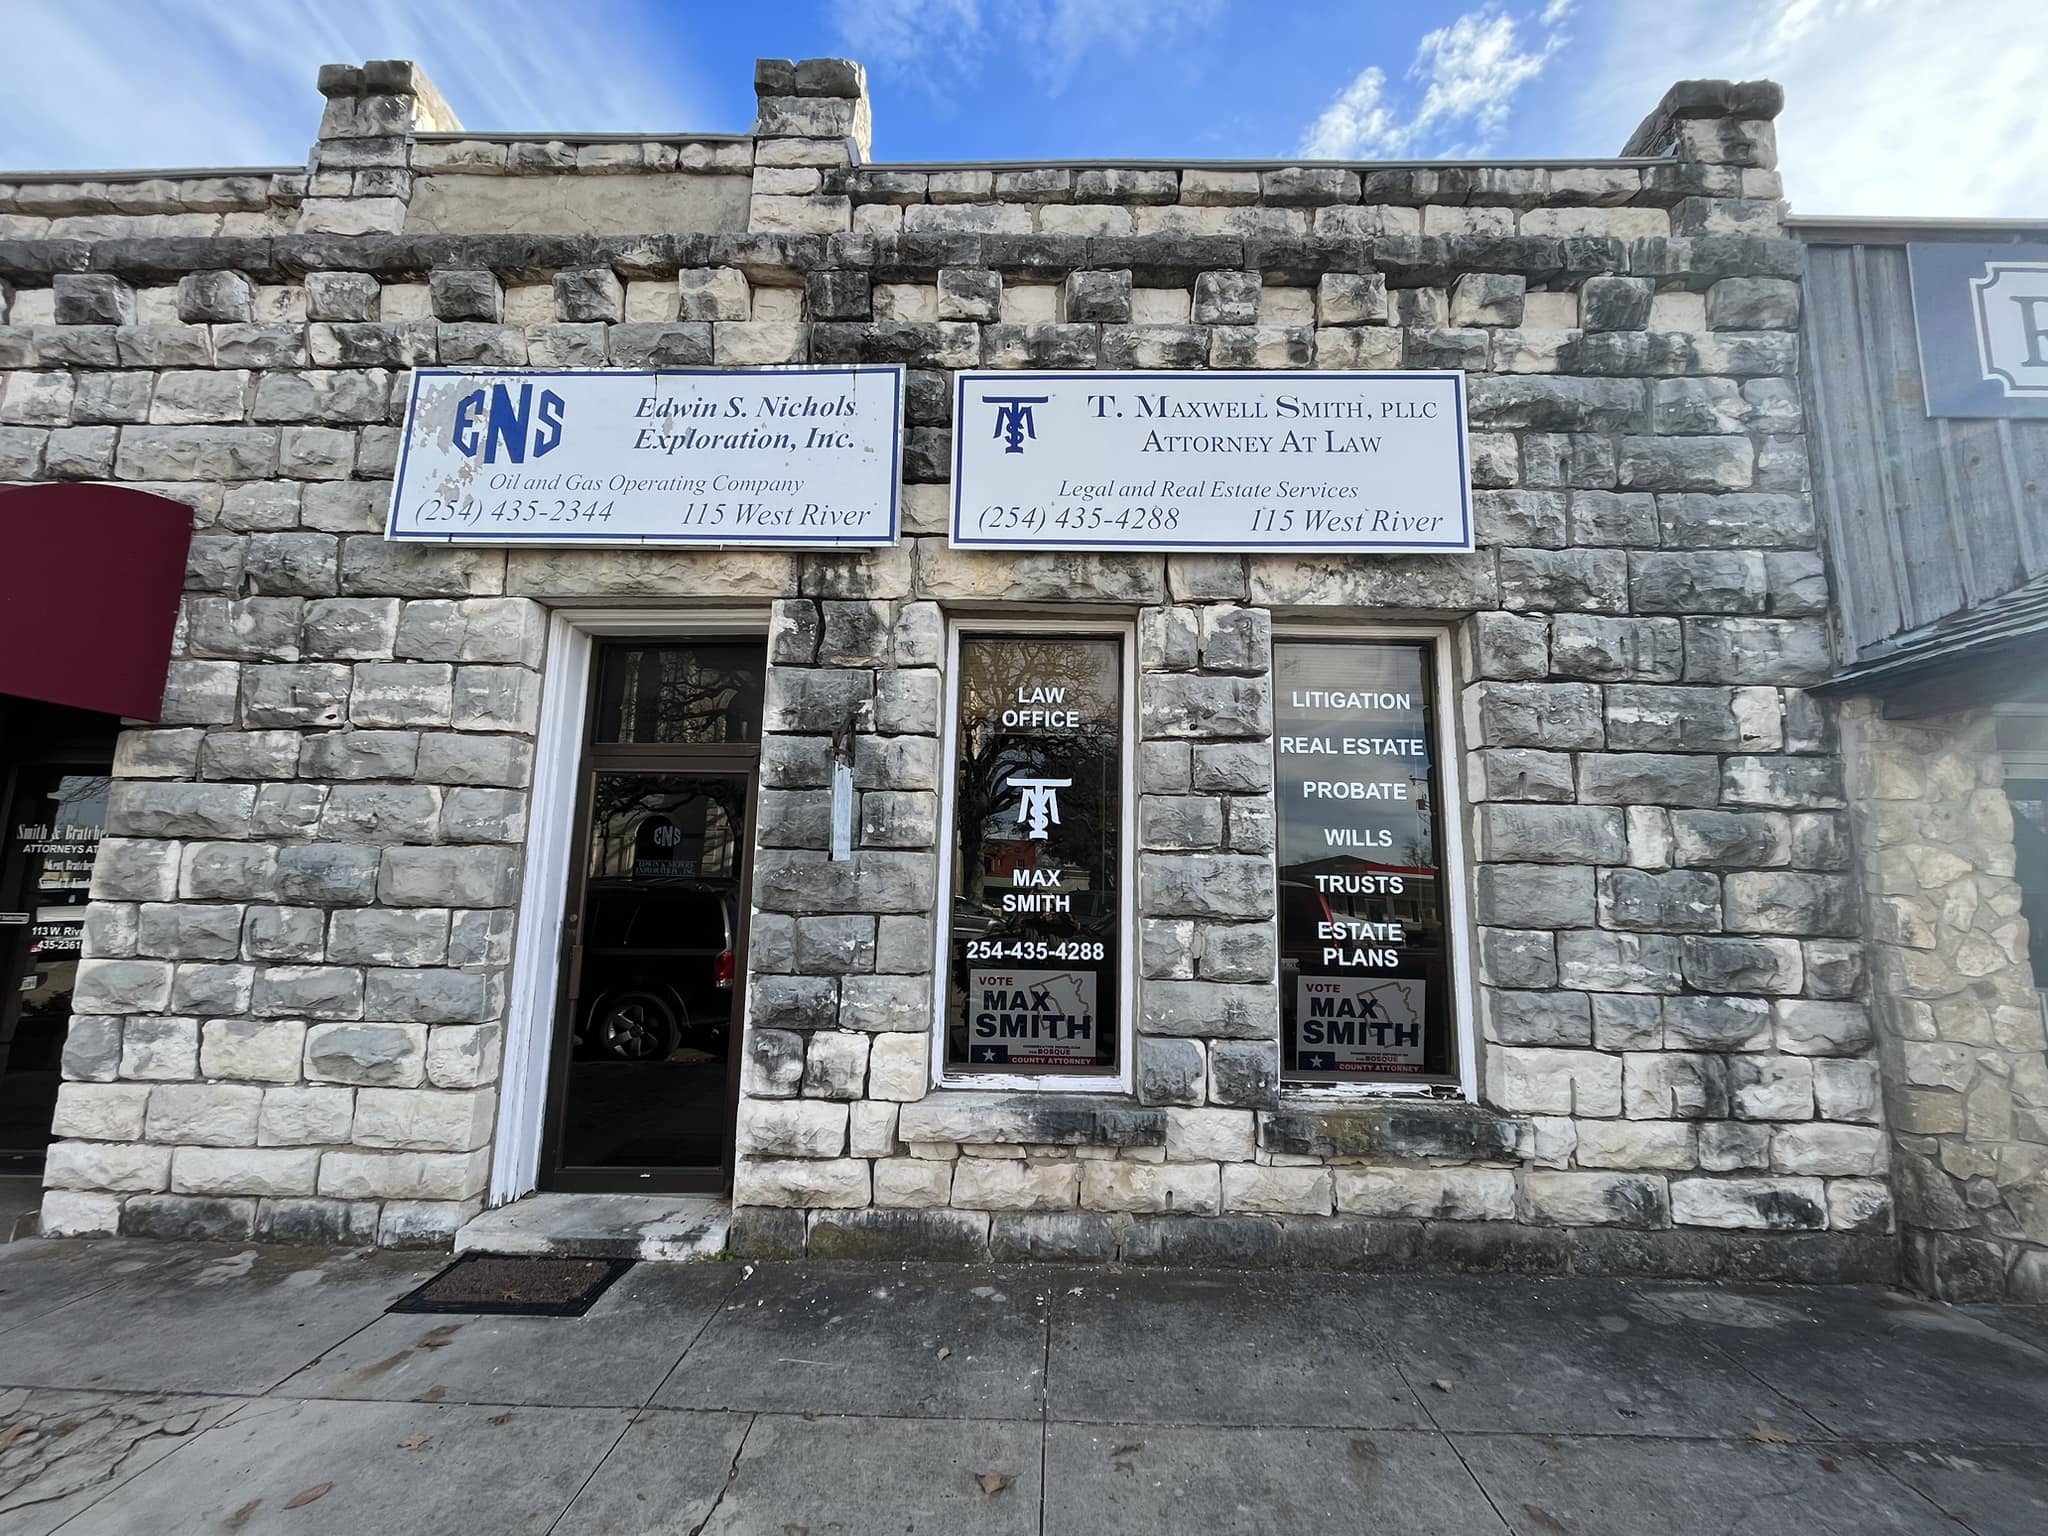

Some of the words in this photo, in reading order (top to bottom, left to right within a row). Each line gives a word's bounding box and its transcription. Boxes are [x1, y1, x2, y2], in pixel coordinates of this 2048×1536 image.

[633, 397, 717, 419] Edwin
[723, 396, 747, 418] S.
[756, 394, 856, 417] Nichols
[1087, 395, 1123, 418] T.
[1381, 402, 1438, 418] PLLC
[452, 384, 565, 464] ENS
[633, 428, 797, 455] Exploration,
[805, 427, 855, 449] Inc.
[489, 473, 520, 491] Oil
[523, 473, 560, 490] and
[565, 474, 603, 492] Gas
[608, 475, 706, 495] Operating
[712, 474, 804, 496] Company
[1058, 480, 1114, 501] Legal
[1119, 480, 1156, 497] and
[1160, 481, 1205, 498] Real
[1210, 481, 1271, 498] Estate
[1276, 481, 1359, 498] Services
[415, 499, 483, 527] (254)
[491, 499, 615, 523] 435-2344
[681, 502, 726, 525] 115
[735, 503, 793, 525] West
[800, 503, 871, 526] River
[978, 505, 1046, 534] (254)
[1055, 507, 1180, 530] 435-4288
[1250, 509, 1294, 532] 115
[1304, 510, 1364, 533] West
[1370, 509, 1443, 533] River
[1018, 687, 1065, 704] LAW
[1292, 690, 1411, 710] LITIGATION
[1001, 709, 1080, 728] OFFICE
[1280, 736, 1338, 755] REAL
[1343, 738, 1425, 756] ESTATE
[1303, 781, 1407, 800] PROBATE
[16, 823, 48, 840] Smith
[64, 824, 109, 841] Bratche
[654, 825, 681, 847] ENS
[1324, 828, 1393, 847] WILLS
[22, 844, 85, 854] ATTORNEYS
[1012, 869, 1062, 887] MAX
[1315, 875, 1404, 894] TRUSTS
[1002, 894, 1071, 913] SMITH
[32, 927, 49, 936] 113
[63, 926, 81, 936] Riv
[1318, 921, 1402, 941] ESTATE
[37, 940, 81, 950] 435-2361
[966, 941, 1105, 960] 254-435-4288
[1323, 947, 1399, 967] PLANS
[978, 976, 1014, 986] VOTE
[1306, 983, 1341, 993] VOTE
[983, 990, 1051, 1012] MAX
[1310, 997, 1379, 1019] MAX
[975, 1013, 1091, 1040] SMITH
[1303, 1020, 1419, 1048] SMITH
[1011, 1056, 1046, 1064] COUNTY
[1047, 1057, 1091, 1065] ATTORNEY
[1339, 1063, 1373, 1071] COUNTY
[1375, 1064, 1419, 1073] ATTORNEY
